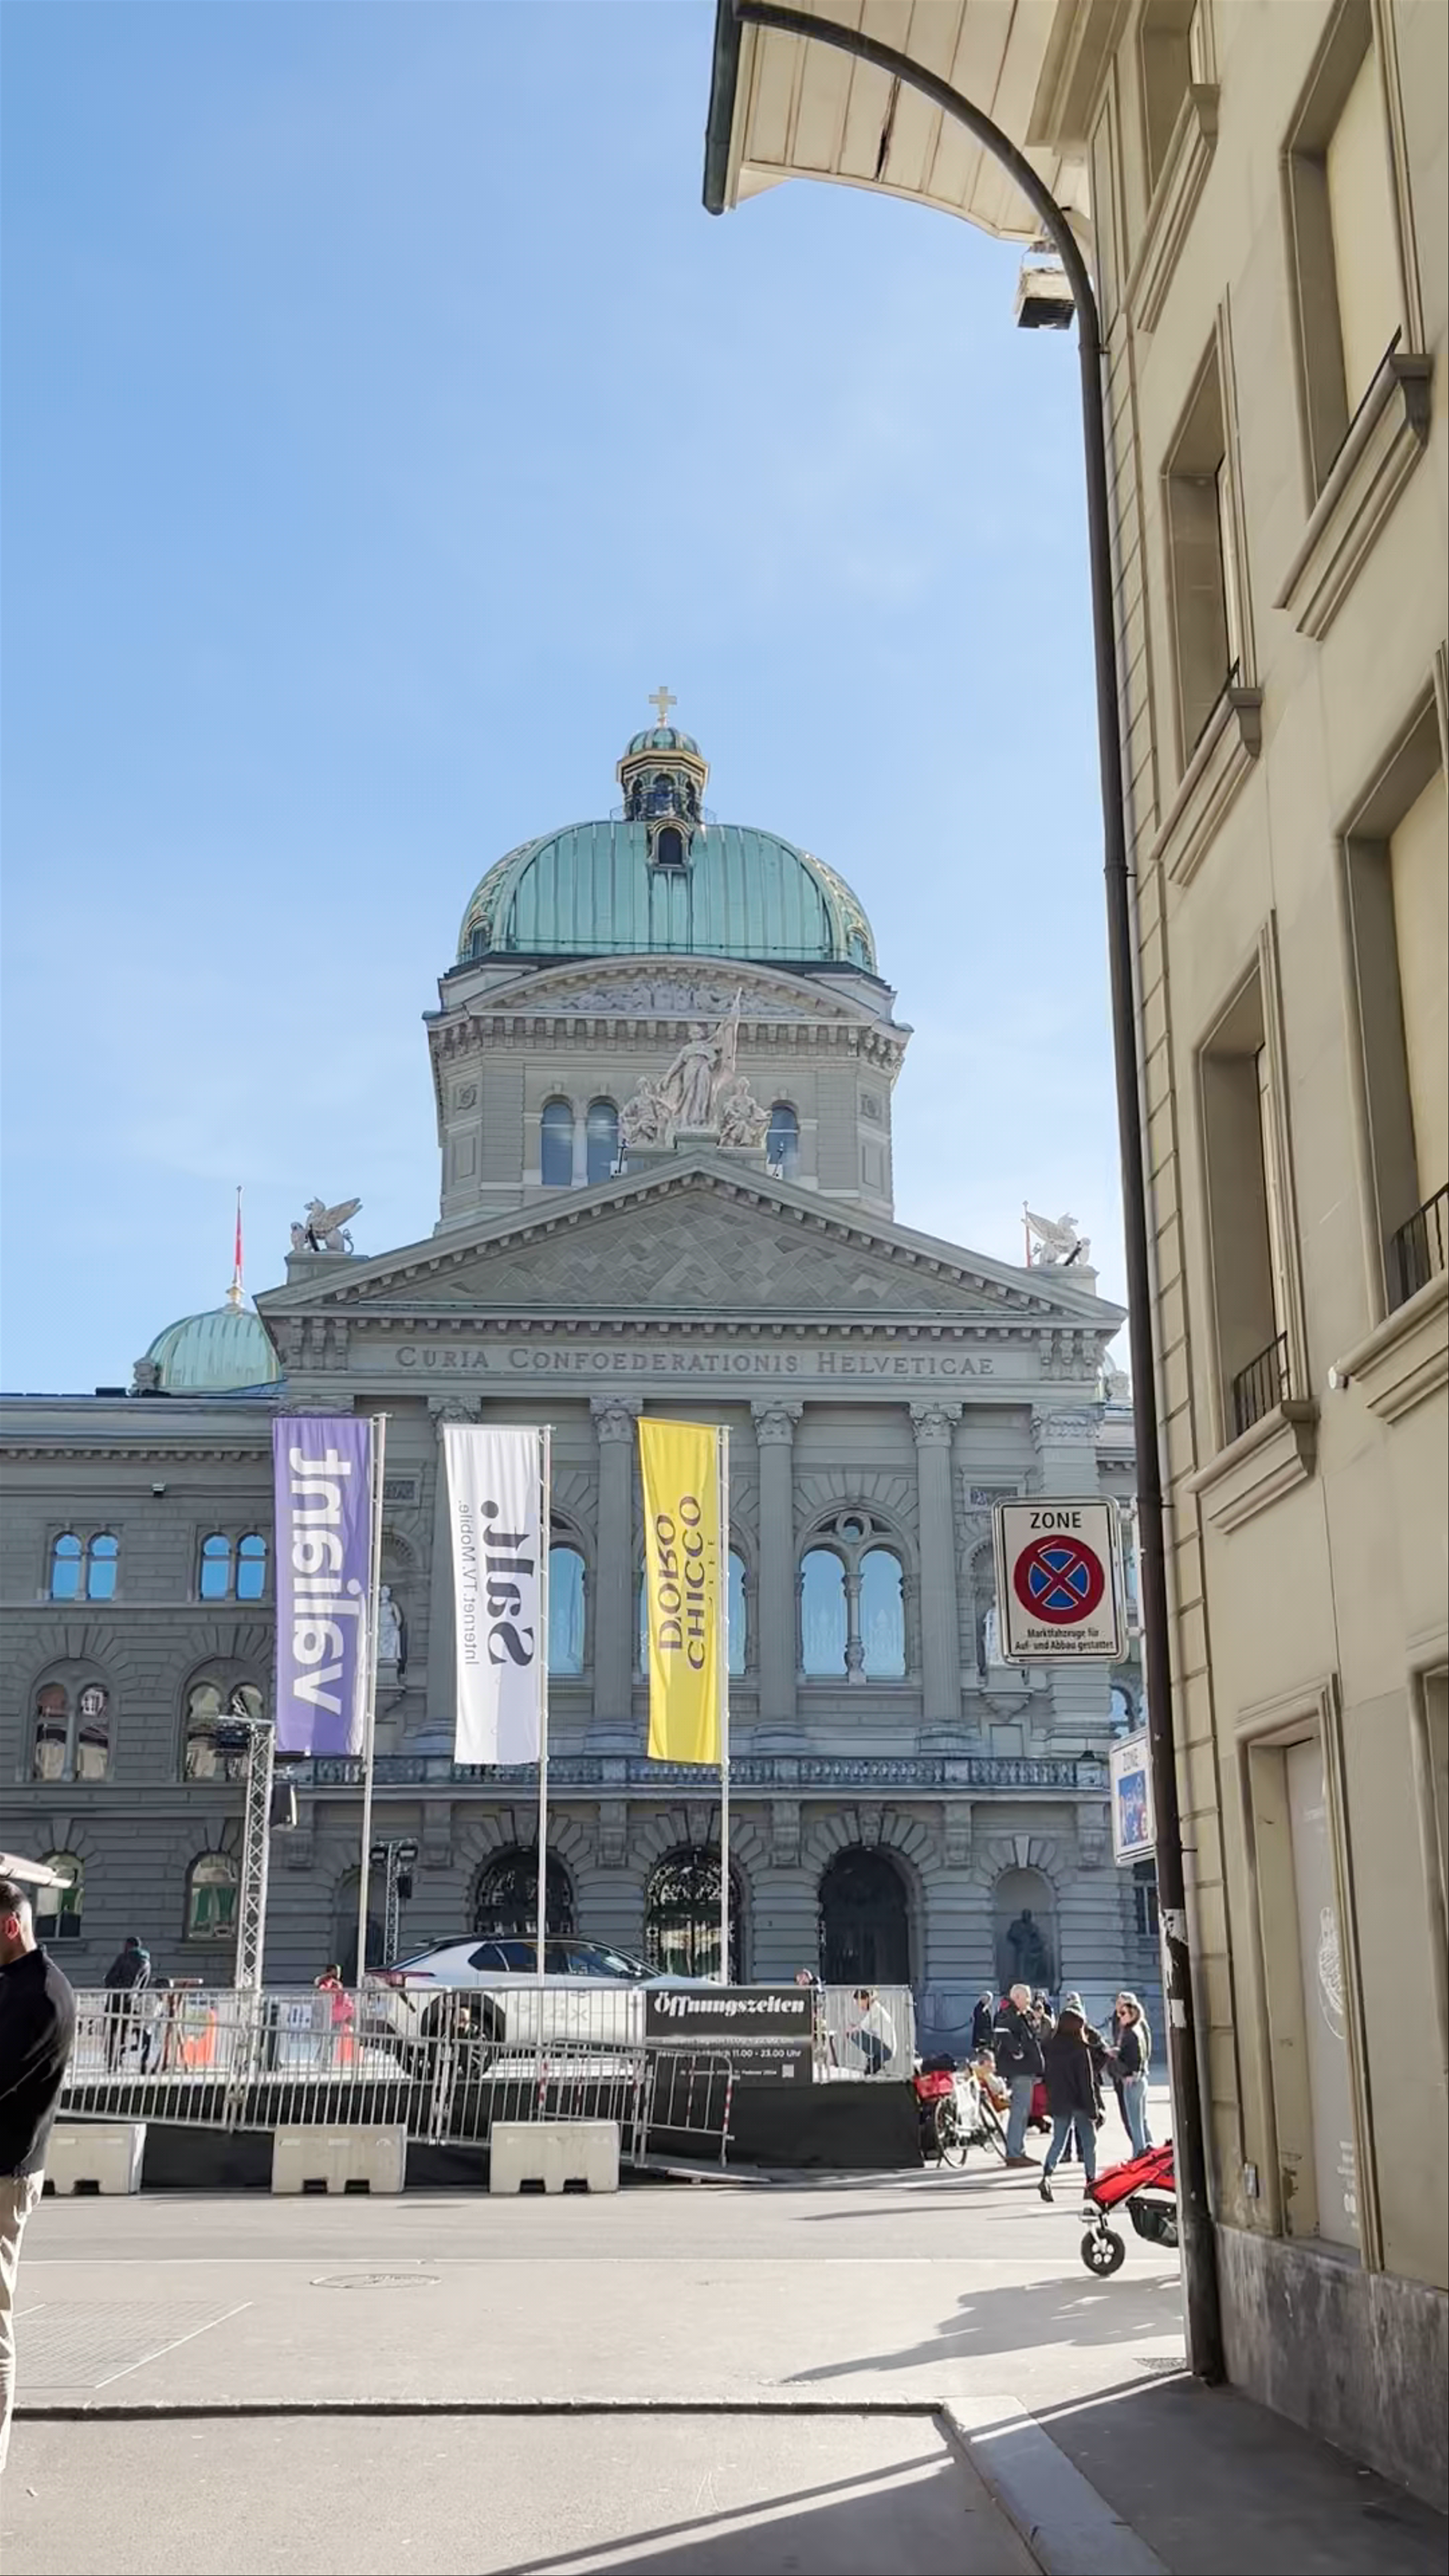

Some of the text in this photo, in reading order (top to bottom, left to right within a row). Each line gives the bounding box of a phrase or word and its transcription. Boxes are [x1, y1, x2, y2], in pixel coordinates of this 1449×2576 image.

[395, 1346, 994, 1375] CURIA CONFOEDERATIONIS HELVETICAE
[1029, 1511, 1081, 1529] ZONE
[1034, 1641, 1049, 1650] und
[654, 1991, 805, 2017] Öffnungszeiten
[786, 2049, 801, 2057] Uhr
